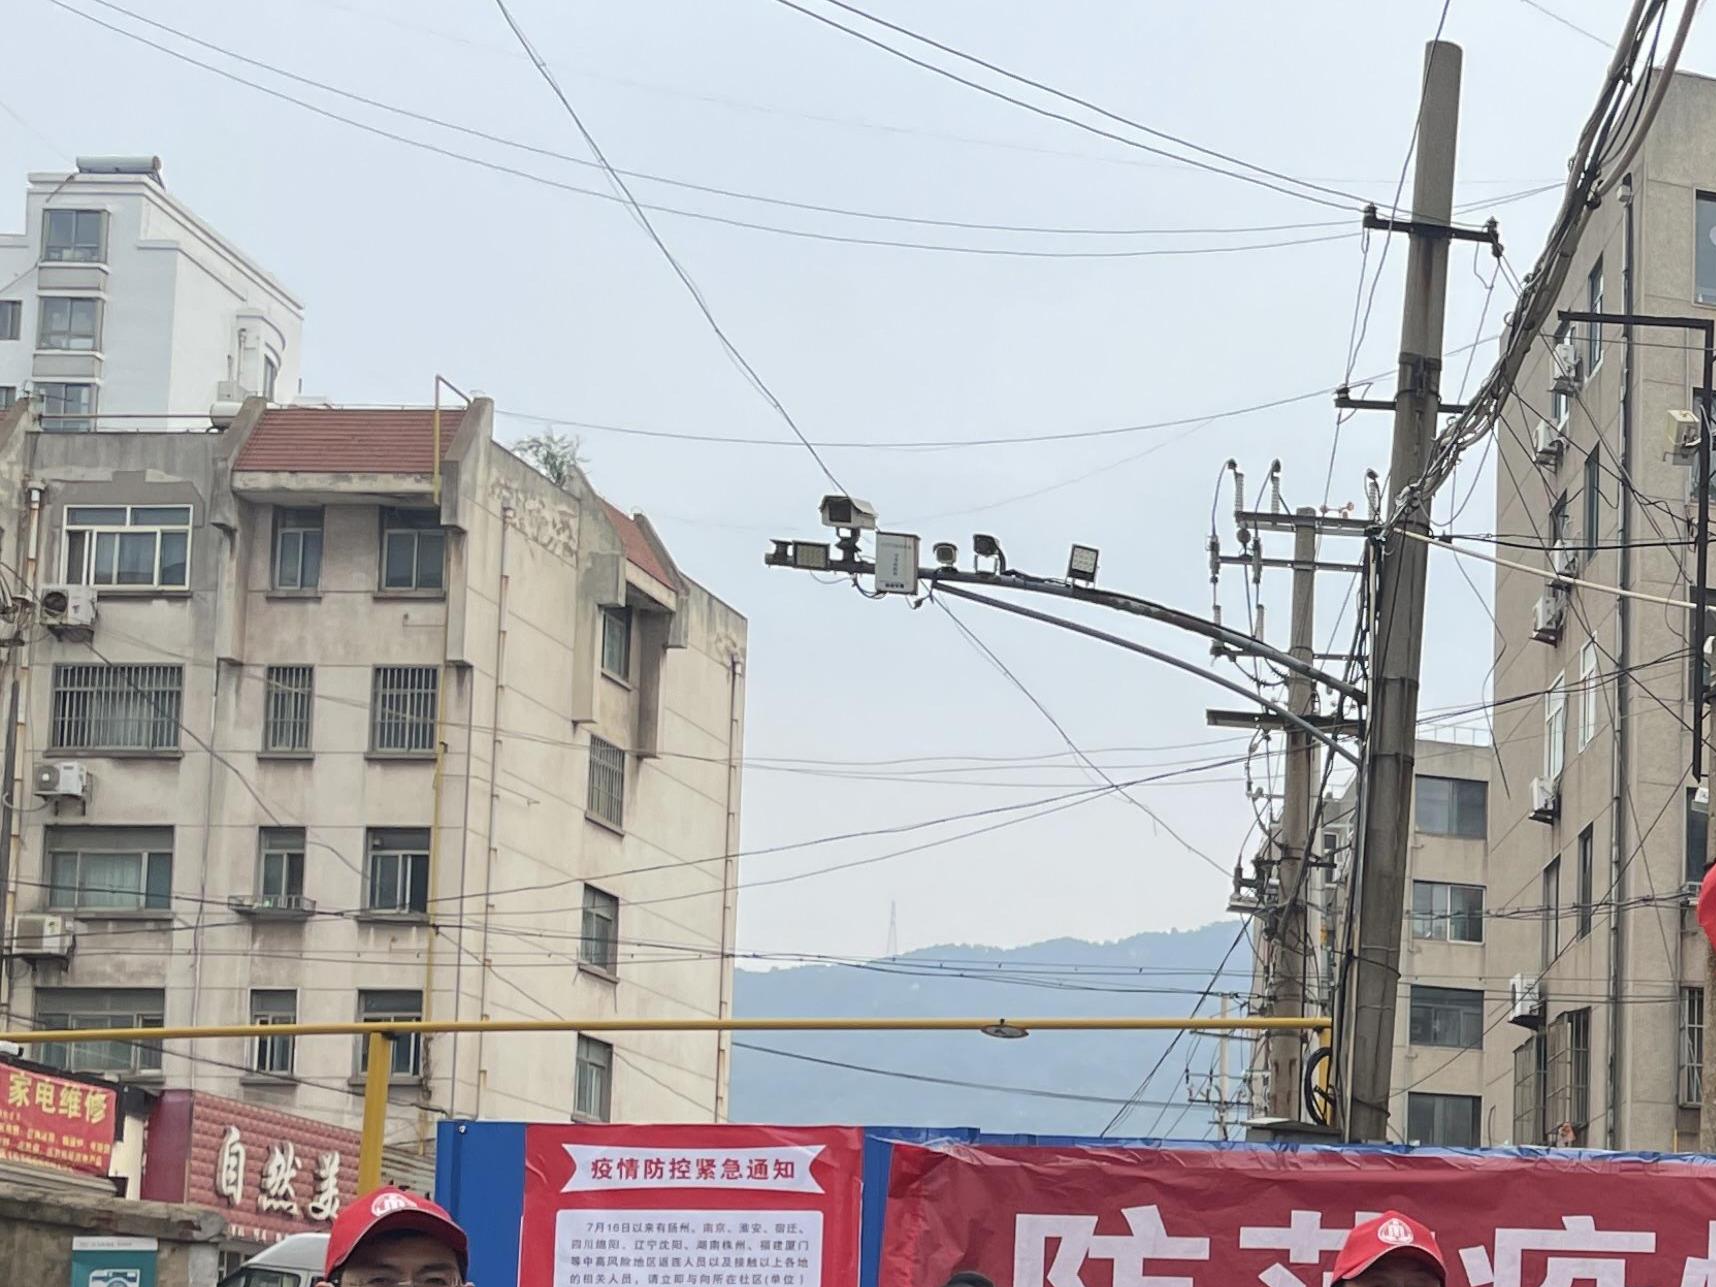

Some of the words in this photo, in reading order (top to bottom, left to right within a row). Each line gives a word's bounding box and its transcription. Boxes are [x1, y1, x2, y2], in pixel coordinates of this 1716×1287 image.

[8, 1071, 107, 1124] 家电维修
[216, 1125, 341, 1222] 自然美
[591, 1157, 795, 1181] 疫情防控紧急通知
